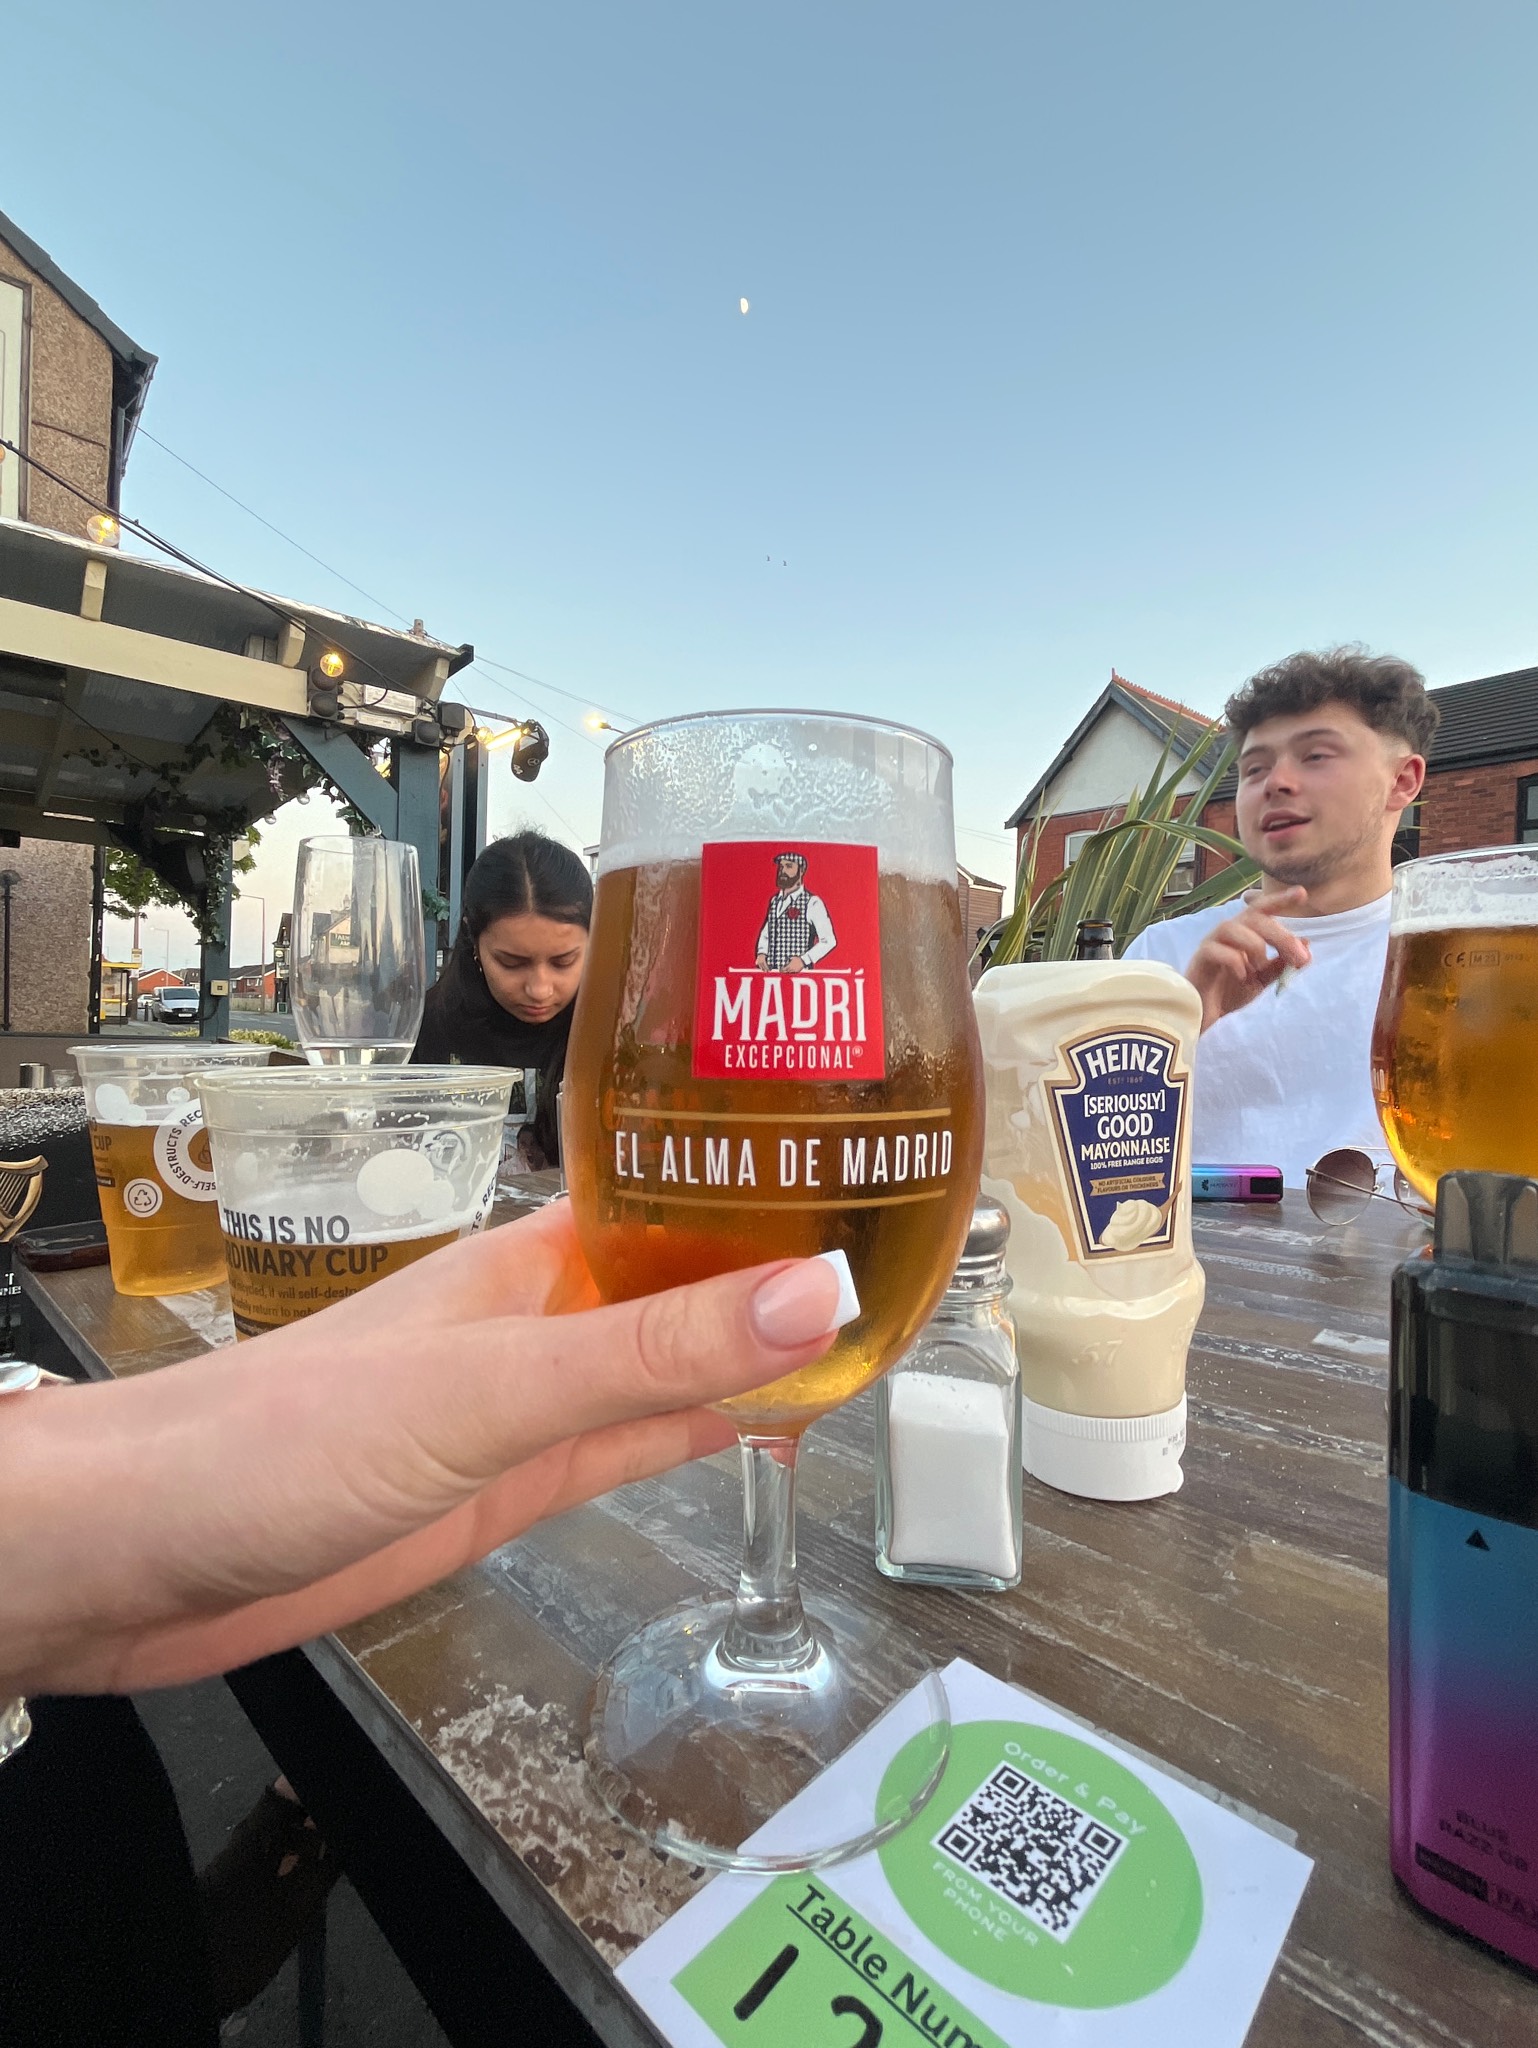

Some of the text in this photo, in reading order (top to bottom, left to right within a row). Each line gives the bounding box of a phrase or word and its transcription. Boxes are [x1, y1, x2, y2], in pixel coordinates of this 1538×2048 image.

[711, 968, 867, 1041] MADRÍ
[724, 1044, 854, 1069] EXCEPCIONAL
[1084, 1043, 1164, 1079] HEINZ
[179, 1109, 204, 1128] REC
[1083, 1089, 1166, 1118] [SERIOUSLY]
[1096, 1112, 1154, 1140] GOOD
[615, 1130, 953, 1187] EL ALMA DE MADRID
[1080, 1136, 1171, 1161] MAYONNAISE
[1090, 1156, 1164, 1170] 100% FREE RANGE EGGS
[223, 1208, 350, 1245] THIS IS NO
[225, 1239, 389, 1278] RDINARY CUP
[278, 1287, 296, 1299] will
[280, 1307, 291, 1317] to
[1004, 1741, 1148, 1836] Order & Pay
[932, 1860, 1040, 1947] FROM YOUR
[943, 1887, 1009, 1943] PHONE
[797, 1883, 985, 2048] Table Num
